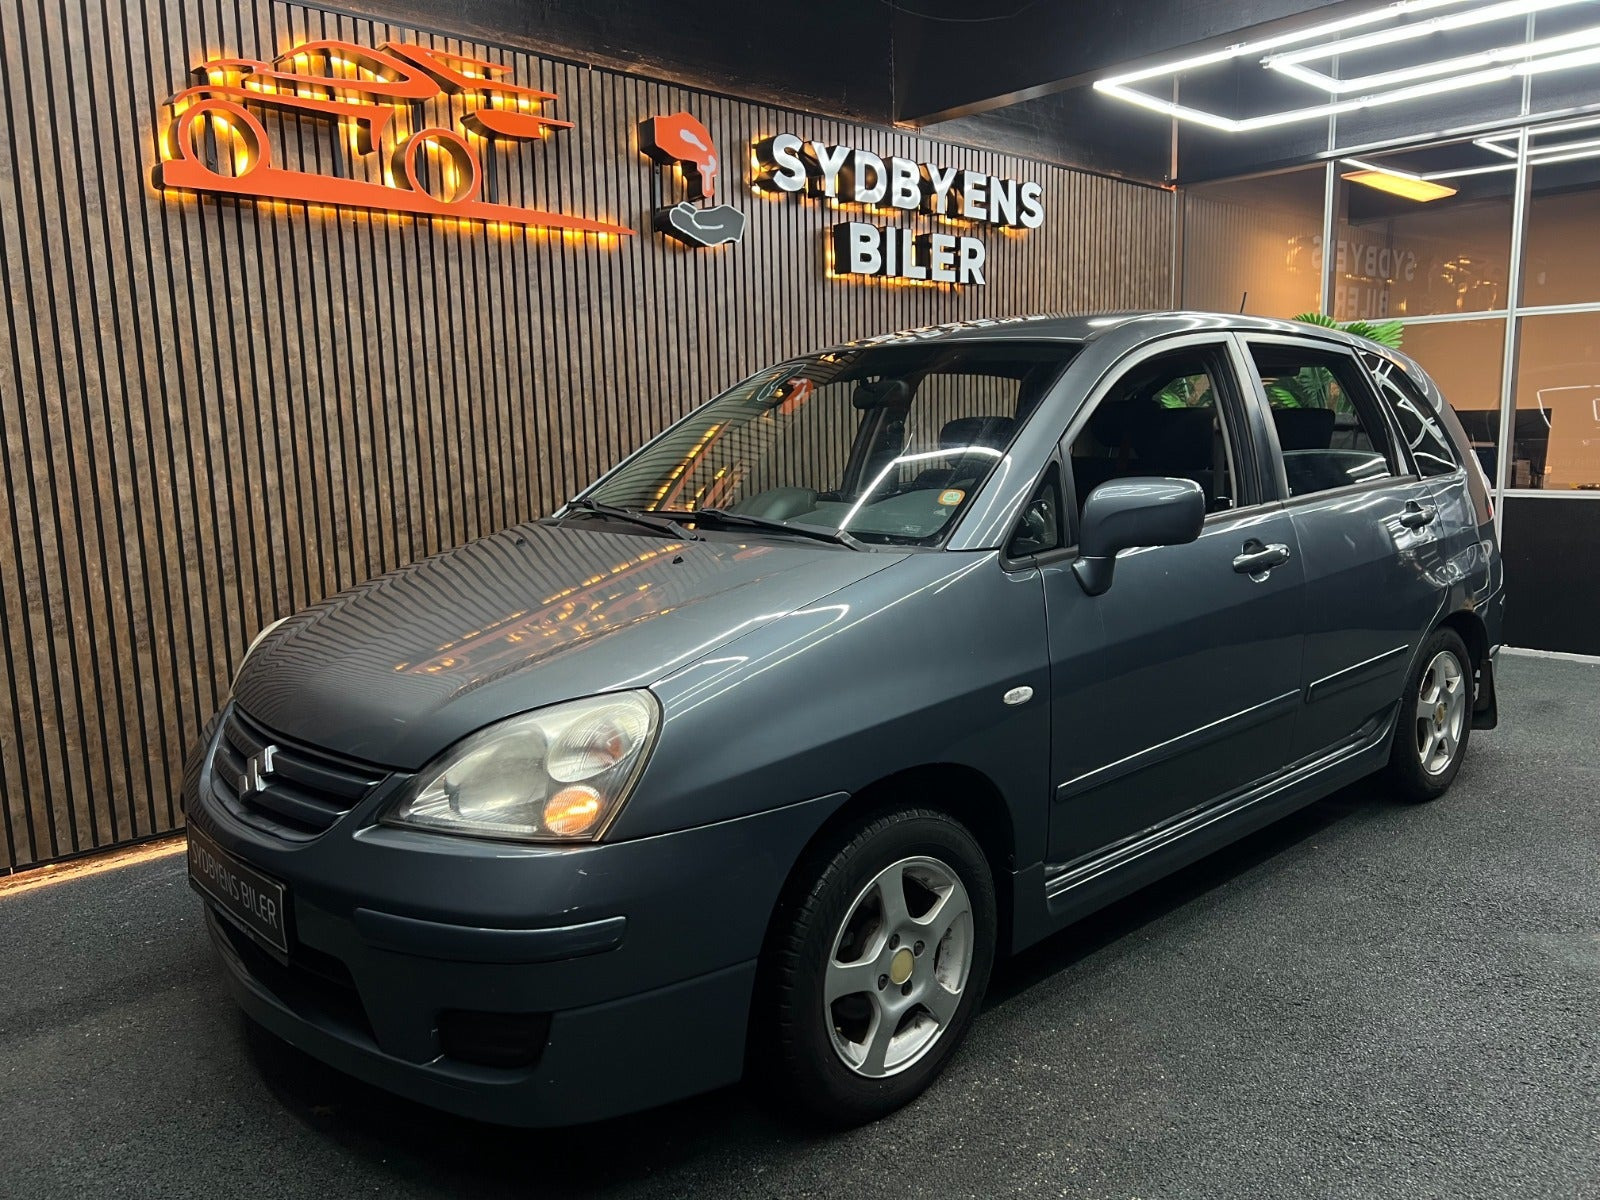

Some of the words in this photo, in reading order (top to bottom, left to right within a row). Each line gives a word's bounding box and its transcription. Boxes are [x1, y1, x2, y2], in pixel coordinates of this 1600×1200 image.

[772, 133, 1045, 229] SYDBYENS
[850, 222, 986, 285] BILER
[191, 840, 240, 901] SYDBYENS
[241, 881, 278, 929] BILER
